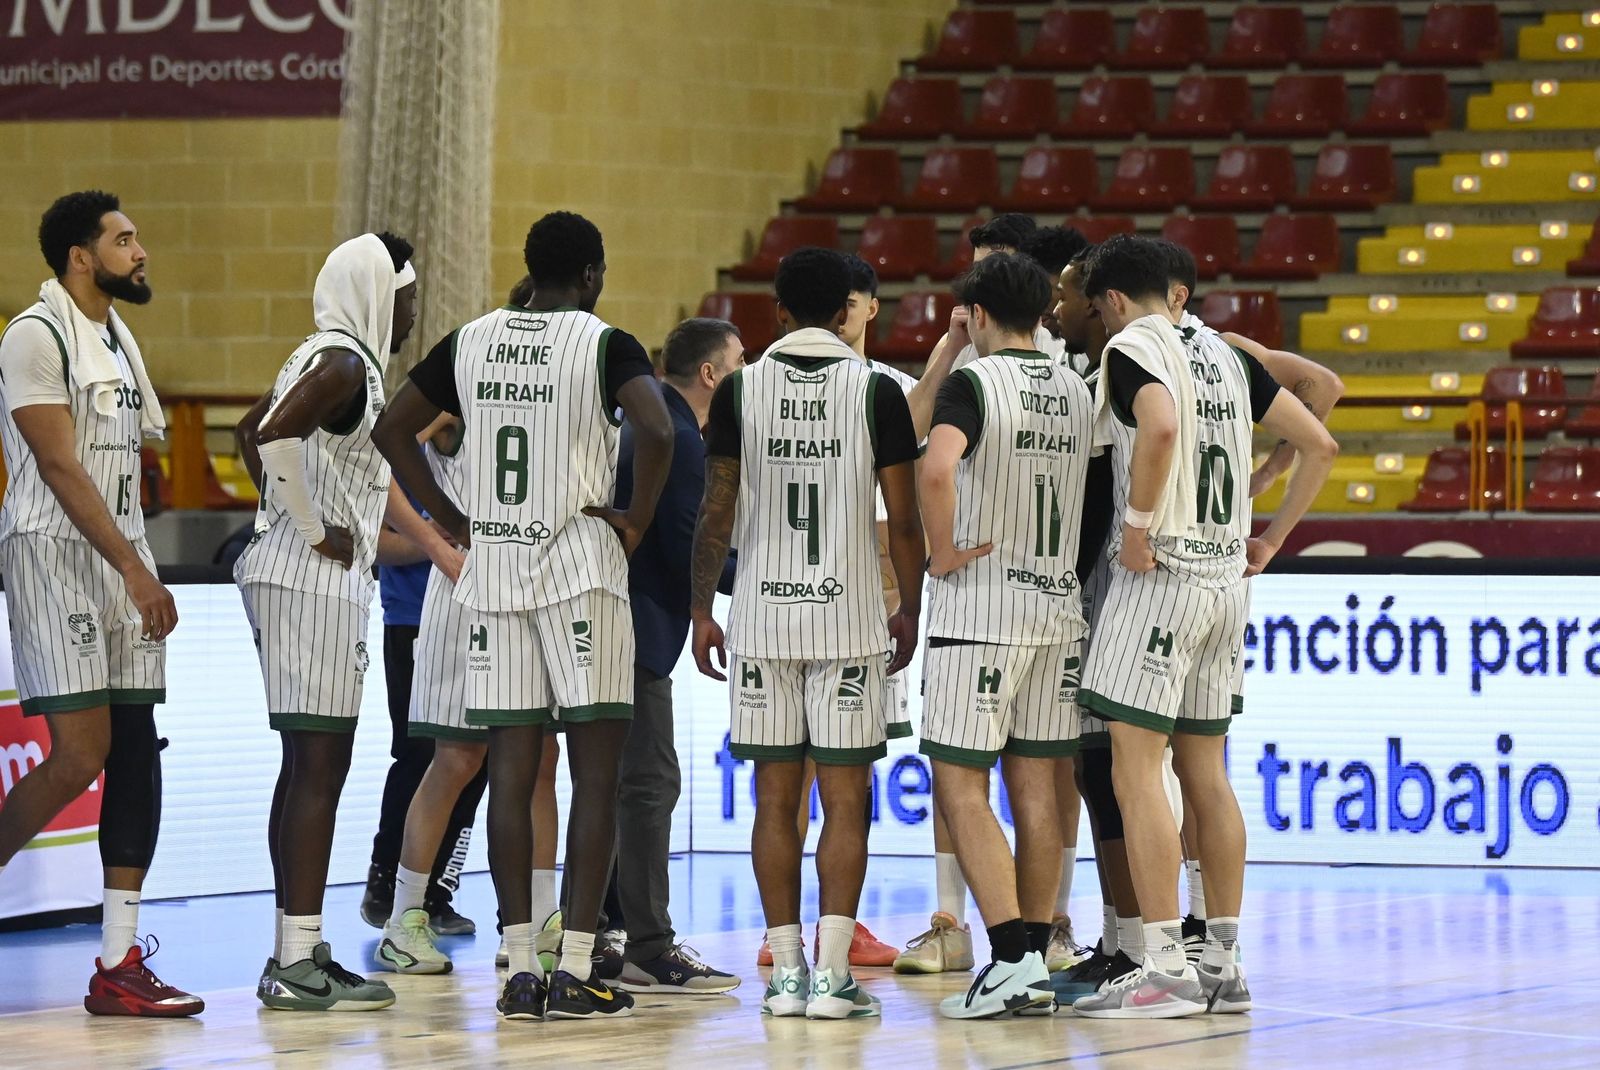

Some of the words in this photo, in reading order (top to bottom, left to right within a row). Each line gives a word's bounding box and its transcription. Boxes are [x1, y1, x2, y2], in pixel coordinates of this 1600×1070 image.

[107, 56, 143, 82] de
[151, 54, 275, 88] Deportes
[486, 343, 551, 366] LAMINE
[505, 383, 554, 403] RAHI
[796, 438, 841, 459] RAHI
[1038, 432, 1076, 455] RAHI
[496, 425, 529, 506] 8
[1197, 440, 1234, 525] 10
[787, 482, 820, 566] 4
[739, 699, 768, 709] Arruzafa
[740, 690, 767, 701] Hospital
[1257, 734, 1570, 859] trabajo
